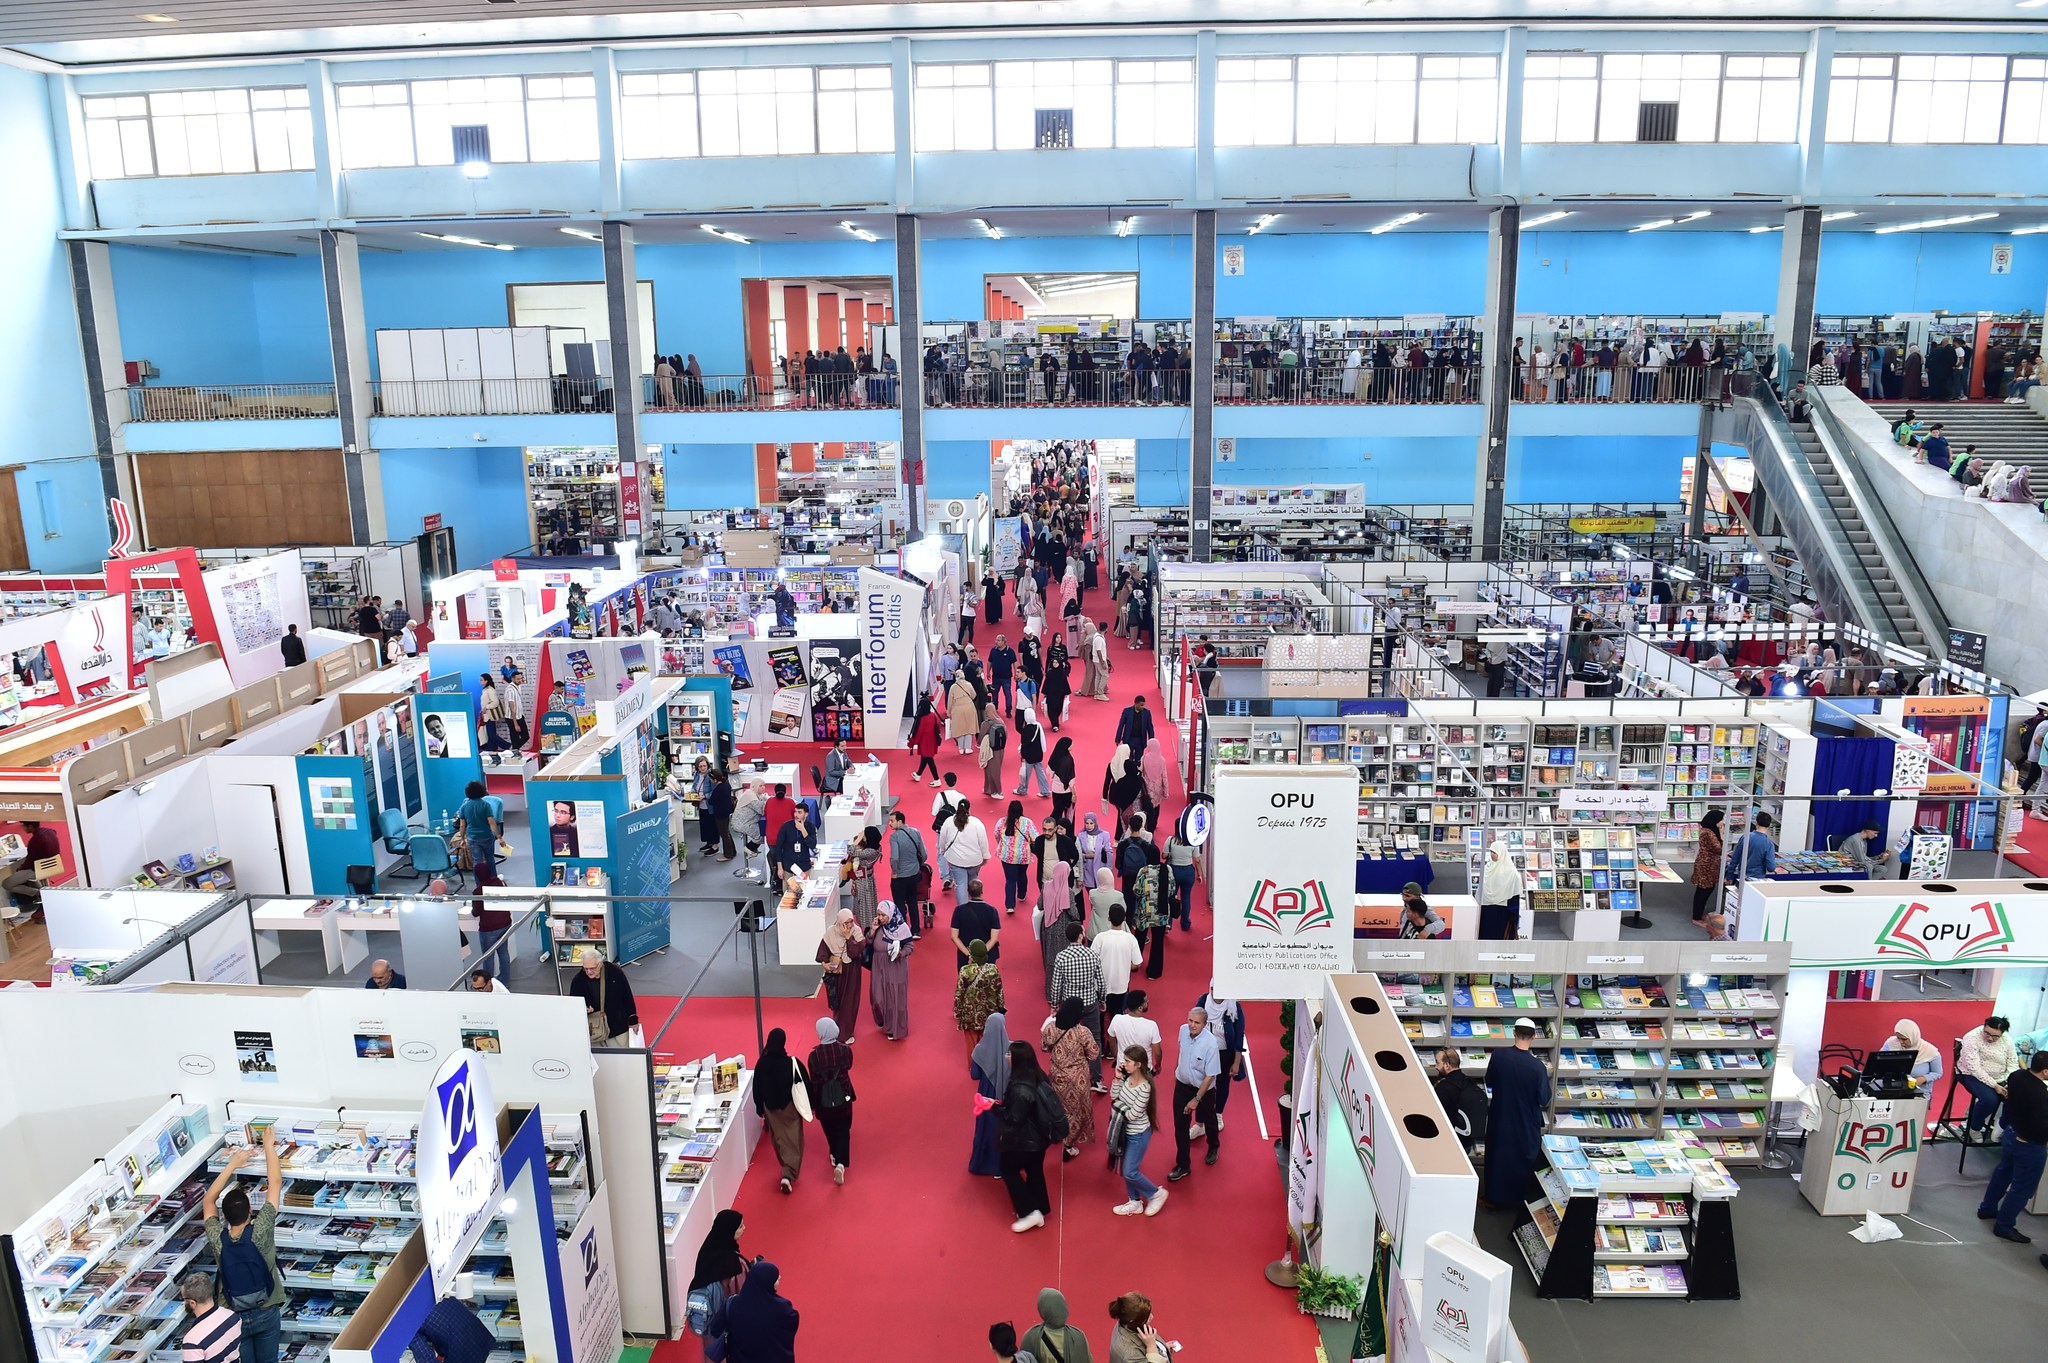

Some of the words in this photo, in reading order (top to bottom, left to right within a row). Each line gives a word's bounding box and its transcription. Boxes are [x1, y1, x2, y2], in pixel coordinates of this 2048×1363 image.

[1256, 507, 1287, 516] مكتبة
[1289, 506, 1312, 516] الجنة
[1314, 506, 1338, 516] تخيلت
[1341, 506, 1364, 514] لطالما
[1580, 519, 1606, 528] القانونية
[1607, 518, 1632, 527] الكتب
[1633, 519, 1645, 527] دار
[887, 594, 902, 640] editis
[717, 651, 727, 661] JEFF
[727, 649, 741, 660] BEZOS
[865, 593, 887, 715] interforum
[1270, 793, 1314, 808] OPU
[1575, 794, 1605, 803] الحكمة
[1608, 796, 1622, 806] دار
[1625, 794, 1650, 803] فضاء
[21, 802, 42, 810] سعاد
[43, 802, 55, 813] دار
[627, 819, 656, 835] DALIMEN
[1257, 816, 1295, 829] Depuis
[1299, 816, 1328, 828] 1975
[1361, 917, 1391, 926] الحكمة
[1922, 923, 1971, 942] OPU
[1242, 942, 1271, 950] الجامعية
[1272, 942, 1312, 950] المطبوعات
[1312, 942, 1334, 950] ديوان
[1237, 952, 1273, 960] University
[1319, 952, 1338, 960] Office
[1351, 1088, 1365, 1132] OPU
[1446, 1266, 1465, 1281] OPU
